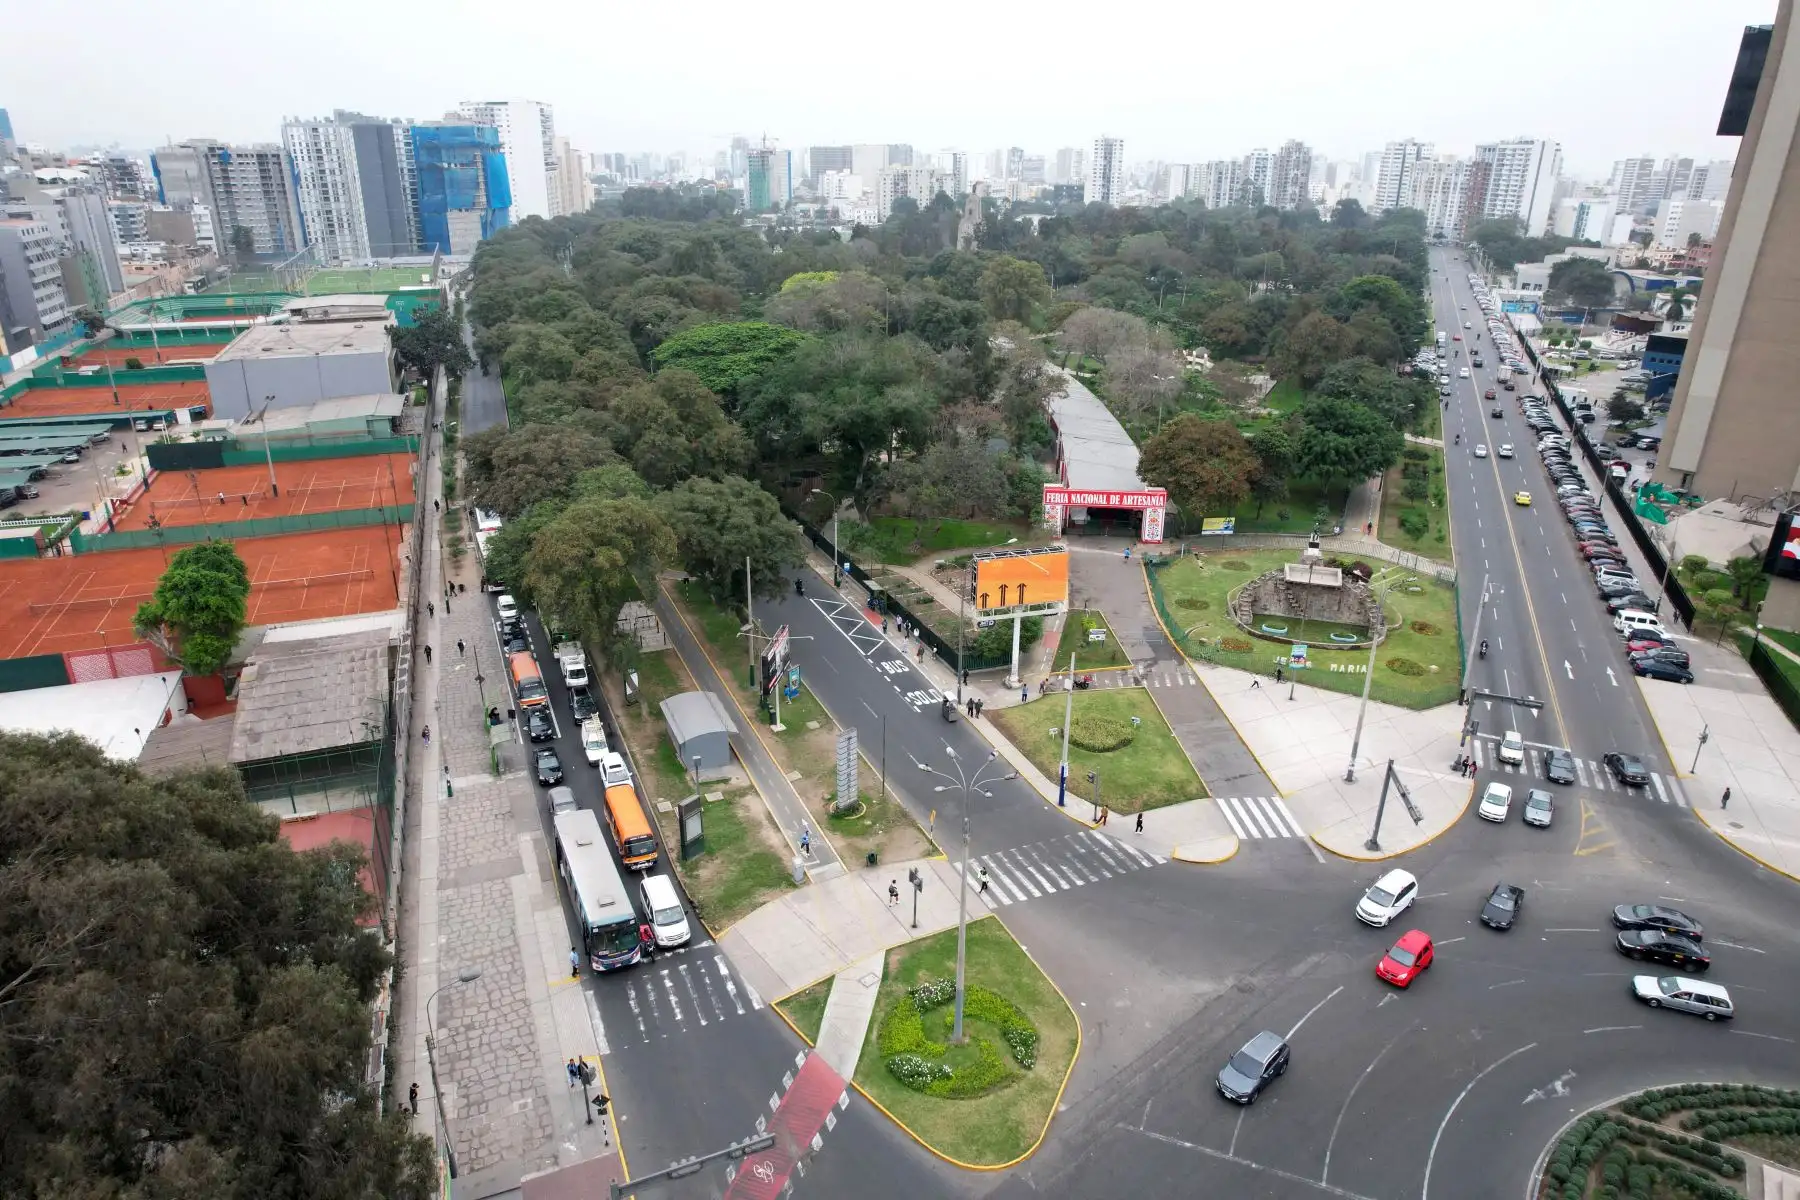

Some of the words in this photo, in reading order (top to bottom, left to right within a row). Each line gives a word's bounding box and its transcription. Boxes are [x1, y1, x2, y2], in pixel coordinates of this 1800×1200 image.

[1046, 492, 1068, 503] FERIA
[1071, 493, 1107, 505] NACIONAL
[1110, 494, 1120, 505] DE
[881, 659, 909, 674] BUS
[1330, 663, 1367, 673] MARIA
[907, 688, 944, 705] SOLO
